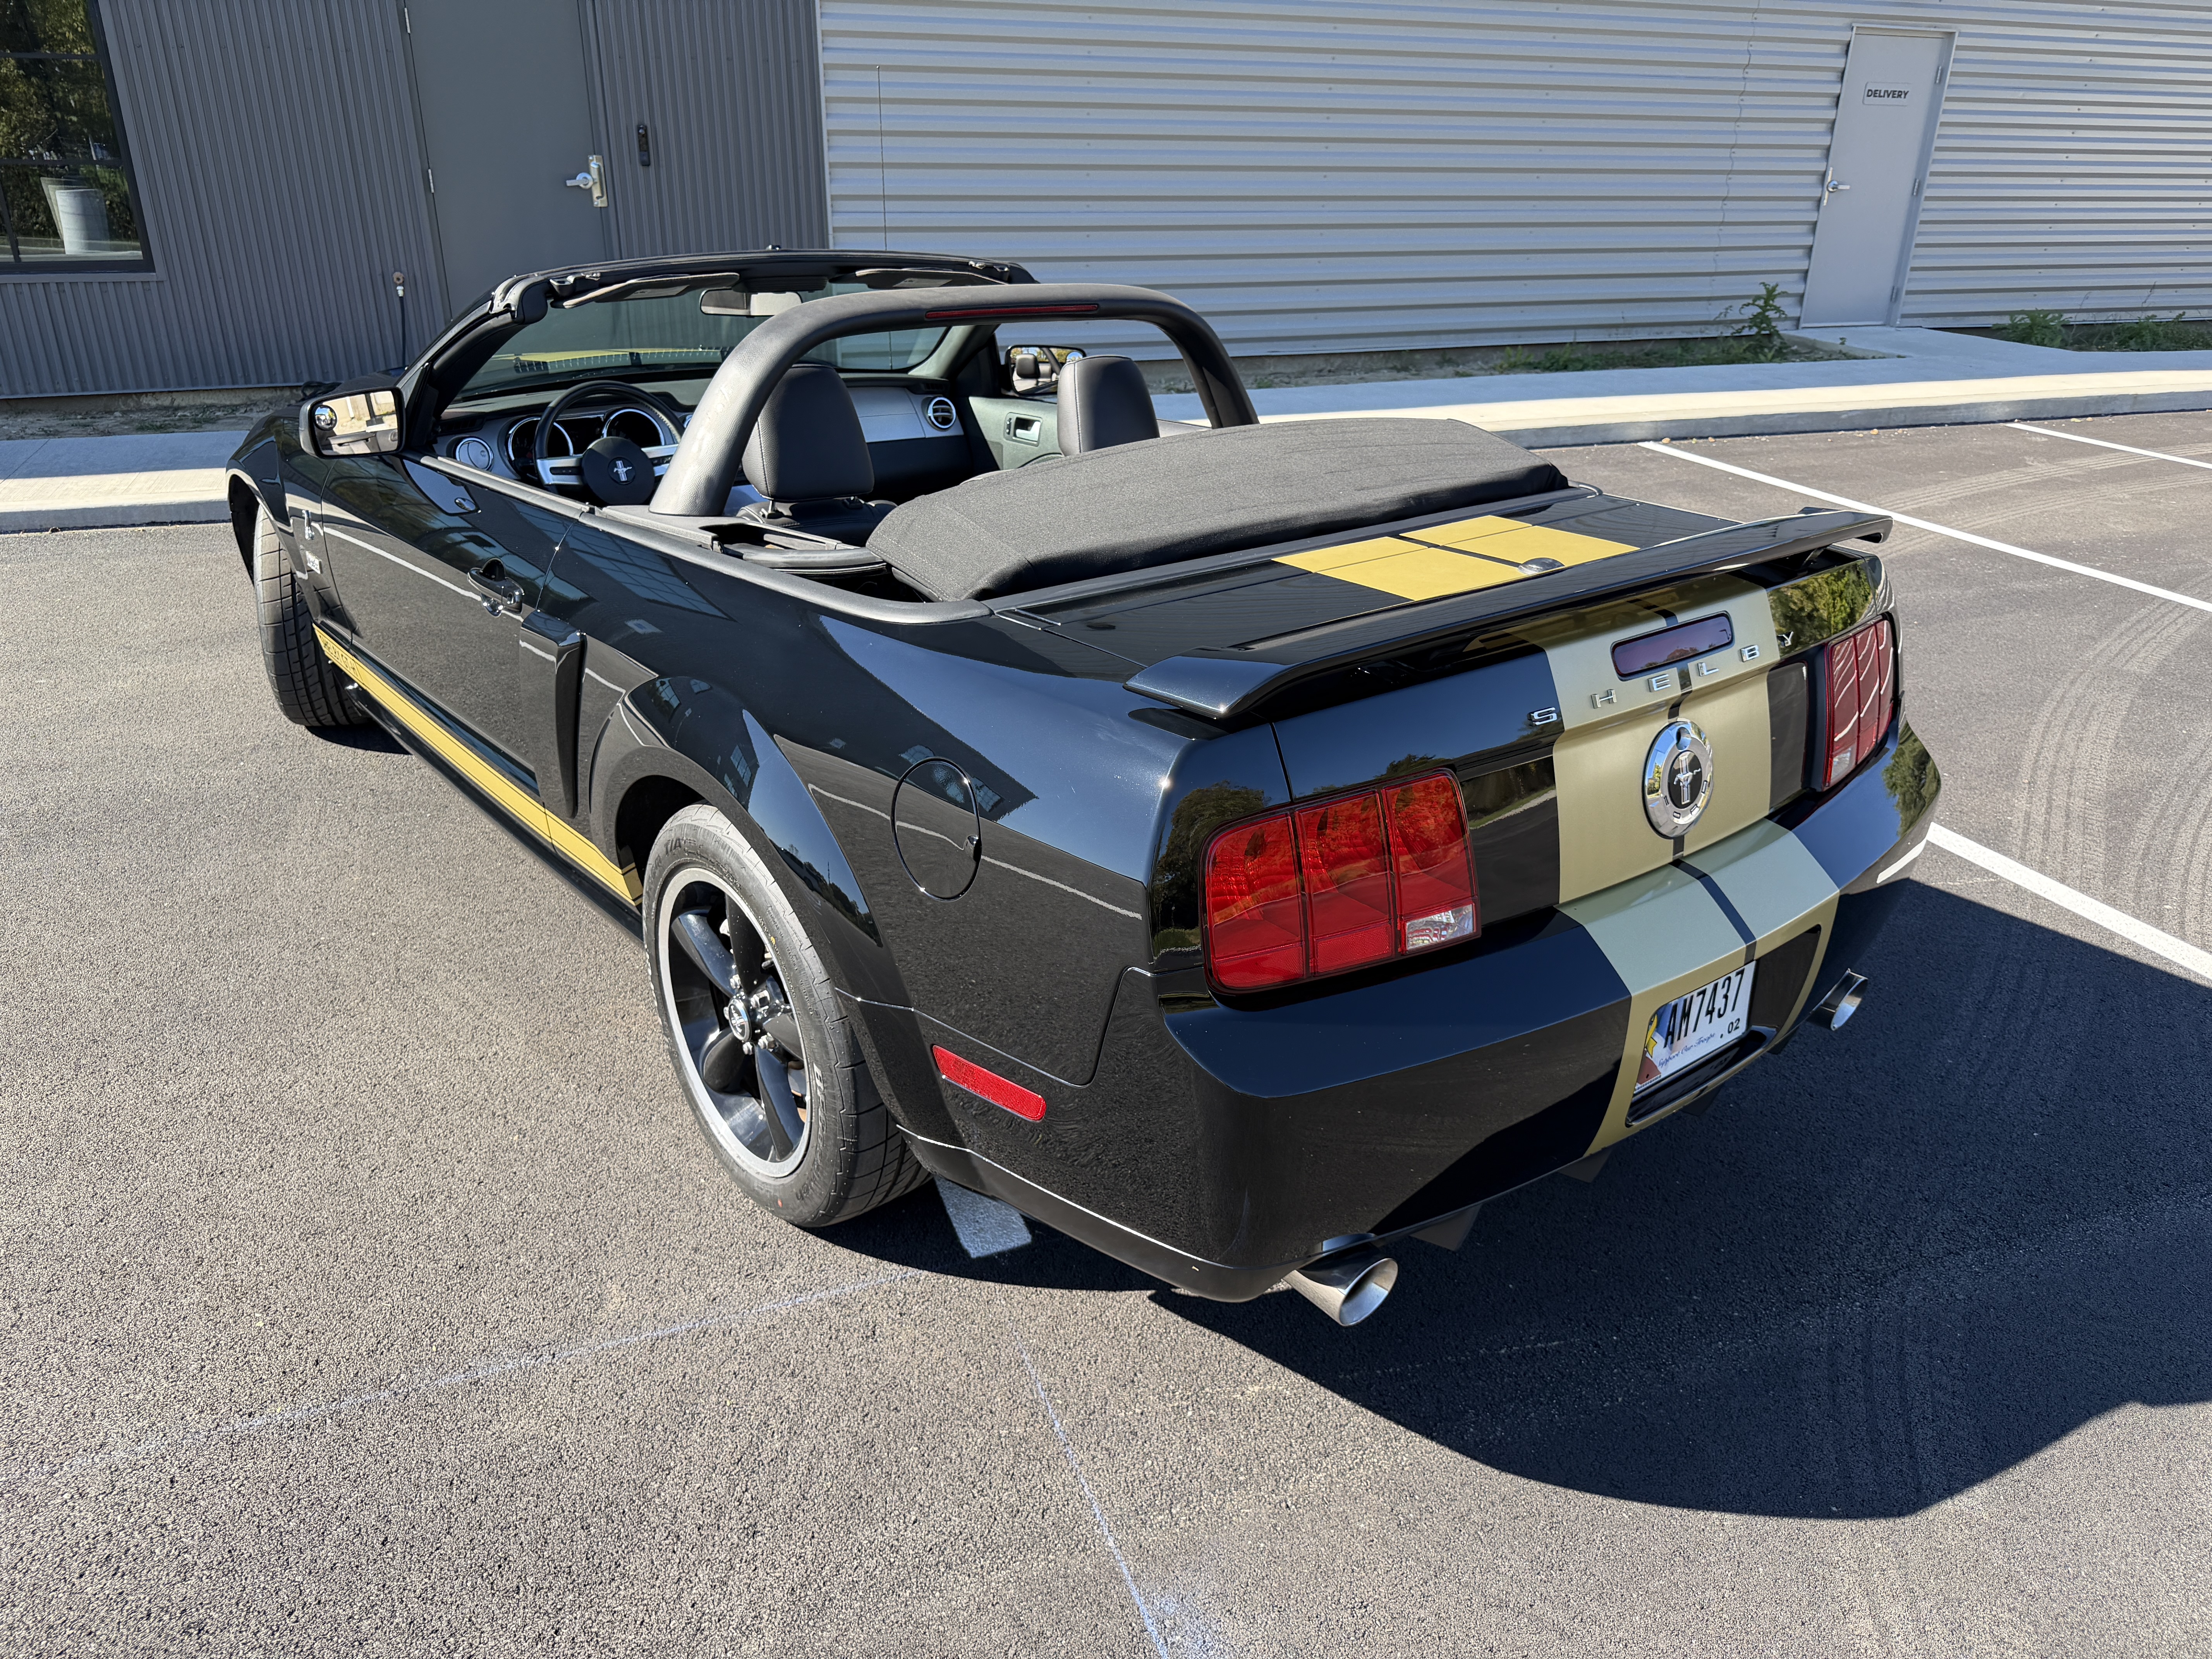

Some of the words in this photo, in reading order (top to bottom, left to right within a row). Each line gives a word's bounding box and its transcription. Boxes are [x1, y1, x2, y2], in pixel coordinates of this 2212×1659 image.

[1866, 89, 1909, 99] DELIVERY
[1527, 631, 1794, 726] SHELBY
[1663, 967, 1745, 1049] AM7437
[1728, 1018, 1740, 1034] 02
